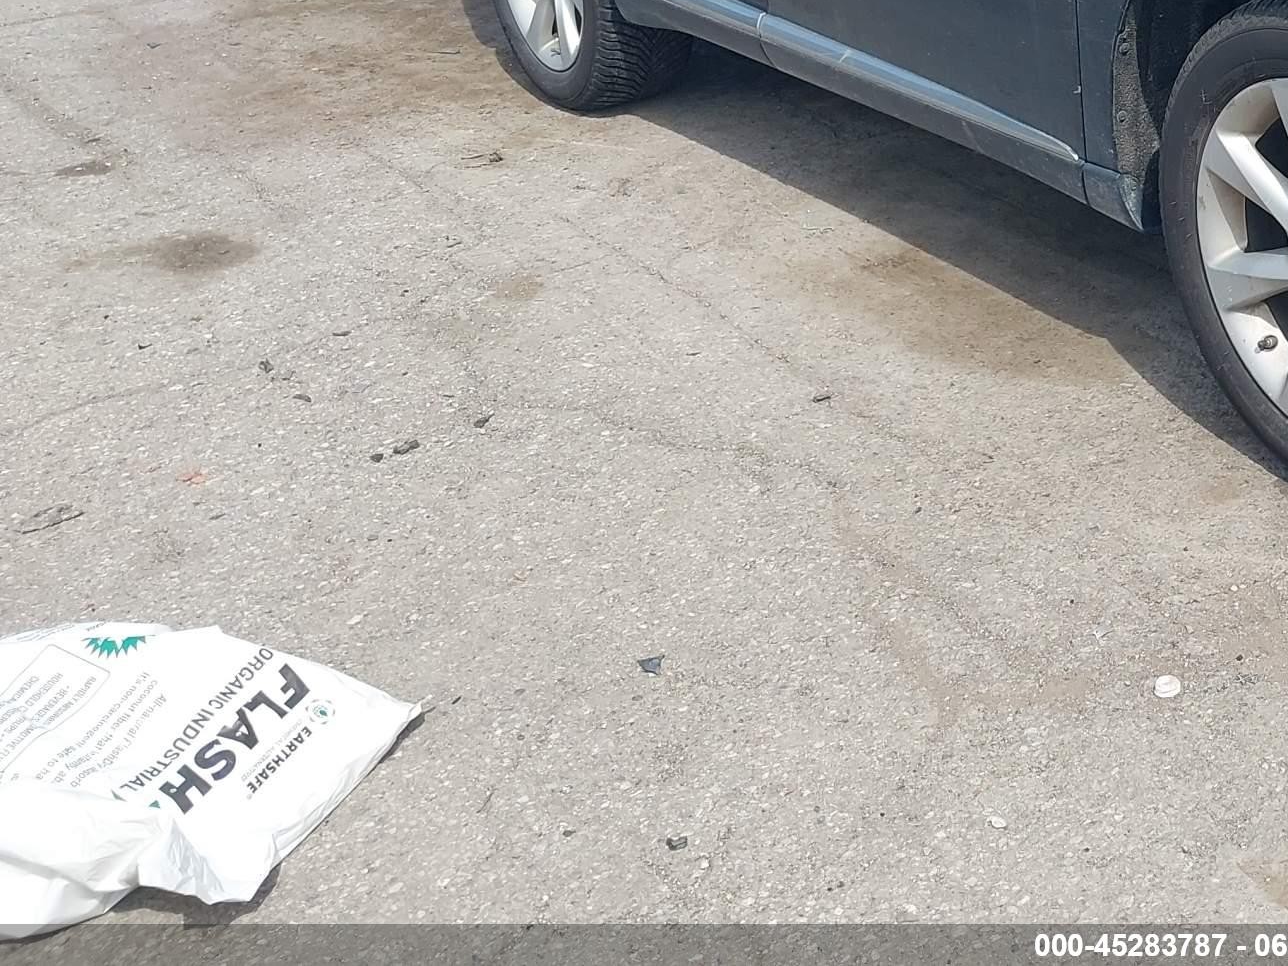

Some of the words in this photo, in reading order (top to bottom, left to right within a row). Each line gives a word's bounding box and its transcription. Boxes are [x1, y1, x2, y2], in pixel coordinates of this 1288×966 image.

[208, 647, 272, 711] ORGANIC
[119, 708, 213, 791] INDUSTRIAL
[158, 663, 310, 815] FLASH
[245, 725, 312, 794] EARTHSAFE
